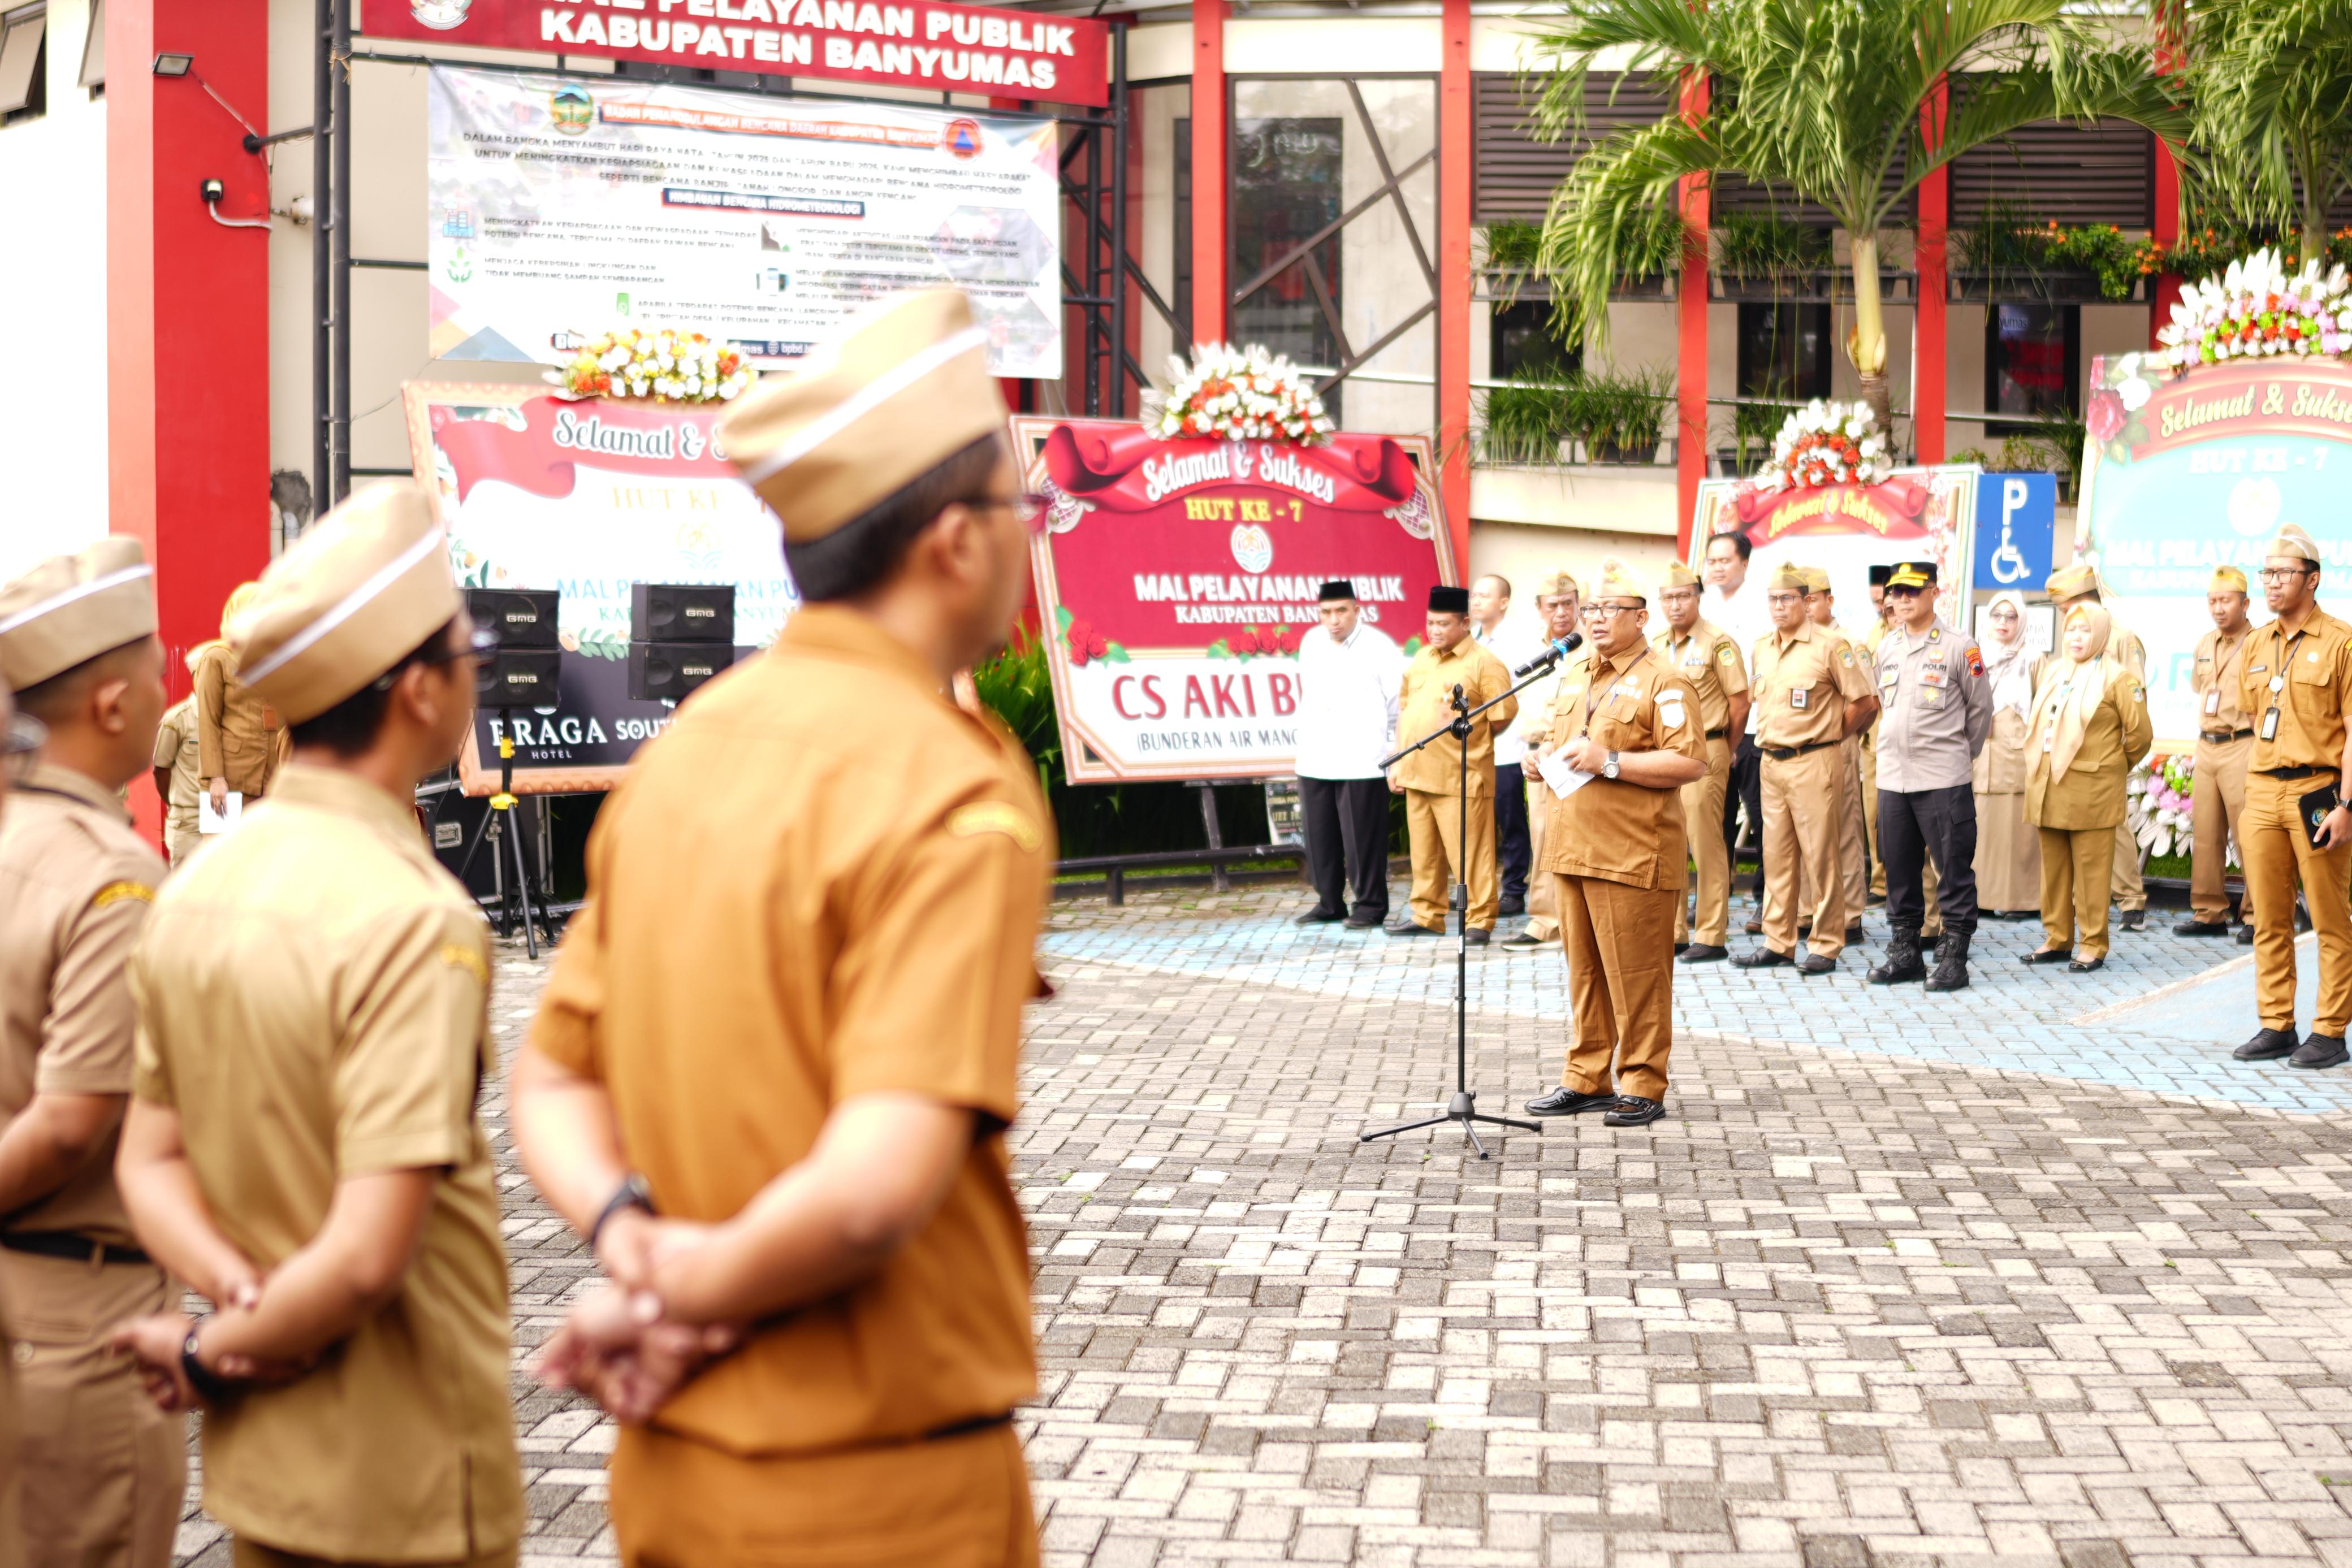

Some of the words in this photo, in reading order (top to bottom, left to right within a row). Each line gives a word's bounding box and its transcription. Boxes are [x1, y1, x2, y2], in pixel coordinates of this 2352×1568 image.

[926, 11, 1075, 56] PUBLIK
[541, 8, 812, 65] KABUPATEN
[825, 37, 1057, 90] BANYUMAS
[604, 105, 640, 118] BADAN
[741, 118, 787, 131] BENCANA
[789, 123, 828, 135] DAERAH
[463, 133, 502, 144] DALAM
[505, 136, 550, 147] RANGKA
[552, 140, 616, 151] MENYAMBUT
[619, 143, 643, 153] HARI
[646, 145, 673, 154] RAYA
[772, 156, 792, 164] DAN
[474, 149, 511, 159] UNTUK
[514, 151, 598, 166] MENINGKATKAN
[599, 157, 681, 170] KESIAPSIAGAAN
[684, 163, 706, 171] DAN
[598, 171, 640, 183] SEPERTI
[642, 174, 690, 186] BENCANA
[822, 188, 842, 197] DAN
[845, 189, 874, 199] ANGIN
[723, 194, 767, 209] BENCANA
[768, 198, 861, 215] HIDROMETEOROLOGI
[484, 217, 554, 227] MENINGKATKAN
[556, 220, 622, 231] KESIAPSIAGAAN
[484, 229, 521, 239] POTENSI
[780, 343, 812, 356] bpbd.b
[2160, 385, 2256, 439] Selamat
[2261, 383, 2285, 417] &
[2291, 383, 2352, 425] Sukse
[554, 410, 676, 460] Selamat
[680, 426, 704, 460] &
[2189, 448, 2247, 474] HUT
[2251, 448, 2288, 473] KE
[2312, 445, 2329, 473] 7
[1142, 445, 1231, 502] Selamat
[1234, 441, 1253, 479] &
[1259, 444, 1335, 504] Sukses
[612, 487, 675, 510] HUT
[687, 488, 725, 510] KE
[1184, 498, 1234, 521] HUT
[1239, 499, 1272, 522] KE
[1289, 500, 1302, 523] 7
[2002, 479, 2027, 525] P
[1840, 490, 1888, 535] Sukses
[2104, 539, 2157, 566] MAL
[2159, 540, 2273, 567] PELAYAN
[556, 578, 610, 599] MAL
[1134, 574, 1189, 601] MAL
[1327, 575, 1406, 601] BLIK
[505, 613, 537, 623] GMG
[685, 609, 715, 618] GMG
[1175, 605, 1280, 624] KABUPATEN
[1282, 605, 1380, 623] BANAS
[508, 674, 538, 684] GMG
[682, 667, 713, 675] GMG
[1922, 663, 1947, 672] POLRI
[1111, 674, 1167, 721] CS
[1183, 673, 1257, 718] AKI
[1137, 731, 1223, 754] (BUNDERAN
[1229, 730, 1253, 748] AIR
[531, 749, 573, 760] HOTEL
